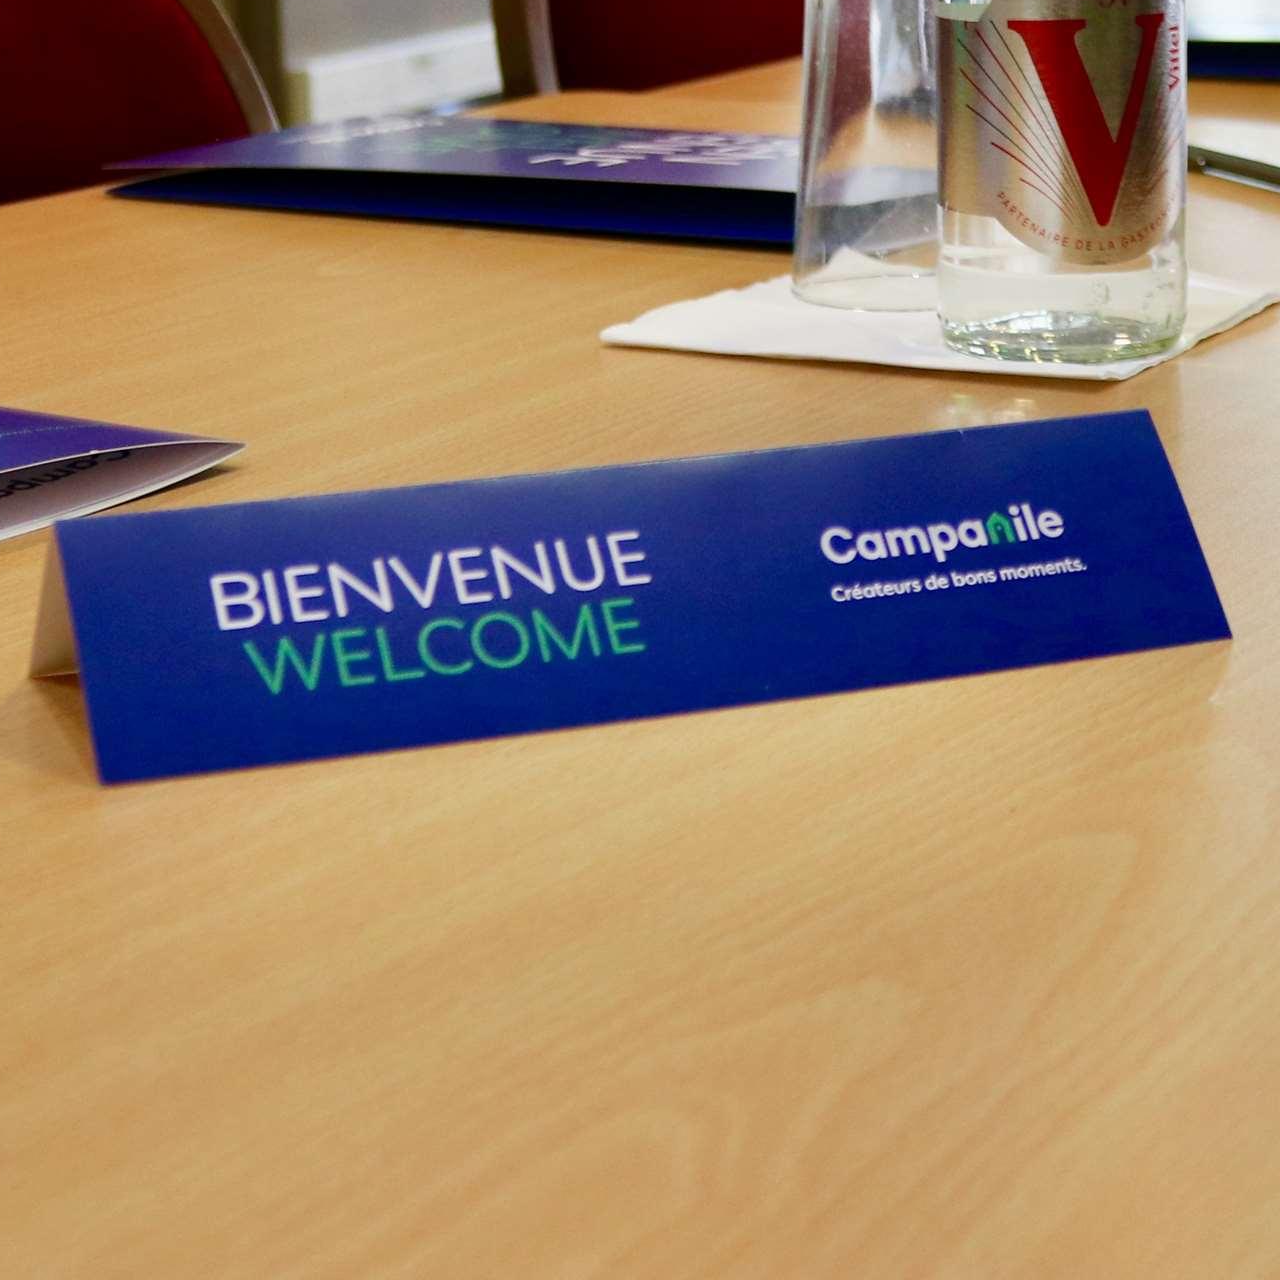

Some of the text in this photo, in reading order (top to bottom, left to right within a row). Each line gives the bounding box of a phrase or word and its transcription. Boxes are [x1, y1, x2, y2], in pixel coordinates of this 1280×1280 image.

[1007, 12, 1165, 228] V
[997, 191, 1070, 248] PARTENAIRE
[1075, 239, 1093, 252] DE
[1098, 240, 1116, 252] LA
[820, 502, 1065, 564] Campanile
[210, 530, 652, 631] BIENVENUE
[831, 556, 1087, 602] Créateurs de bons moments.
[242, 598, 646, 695] WELCOME
